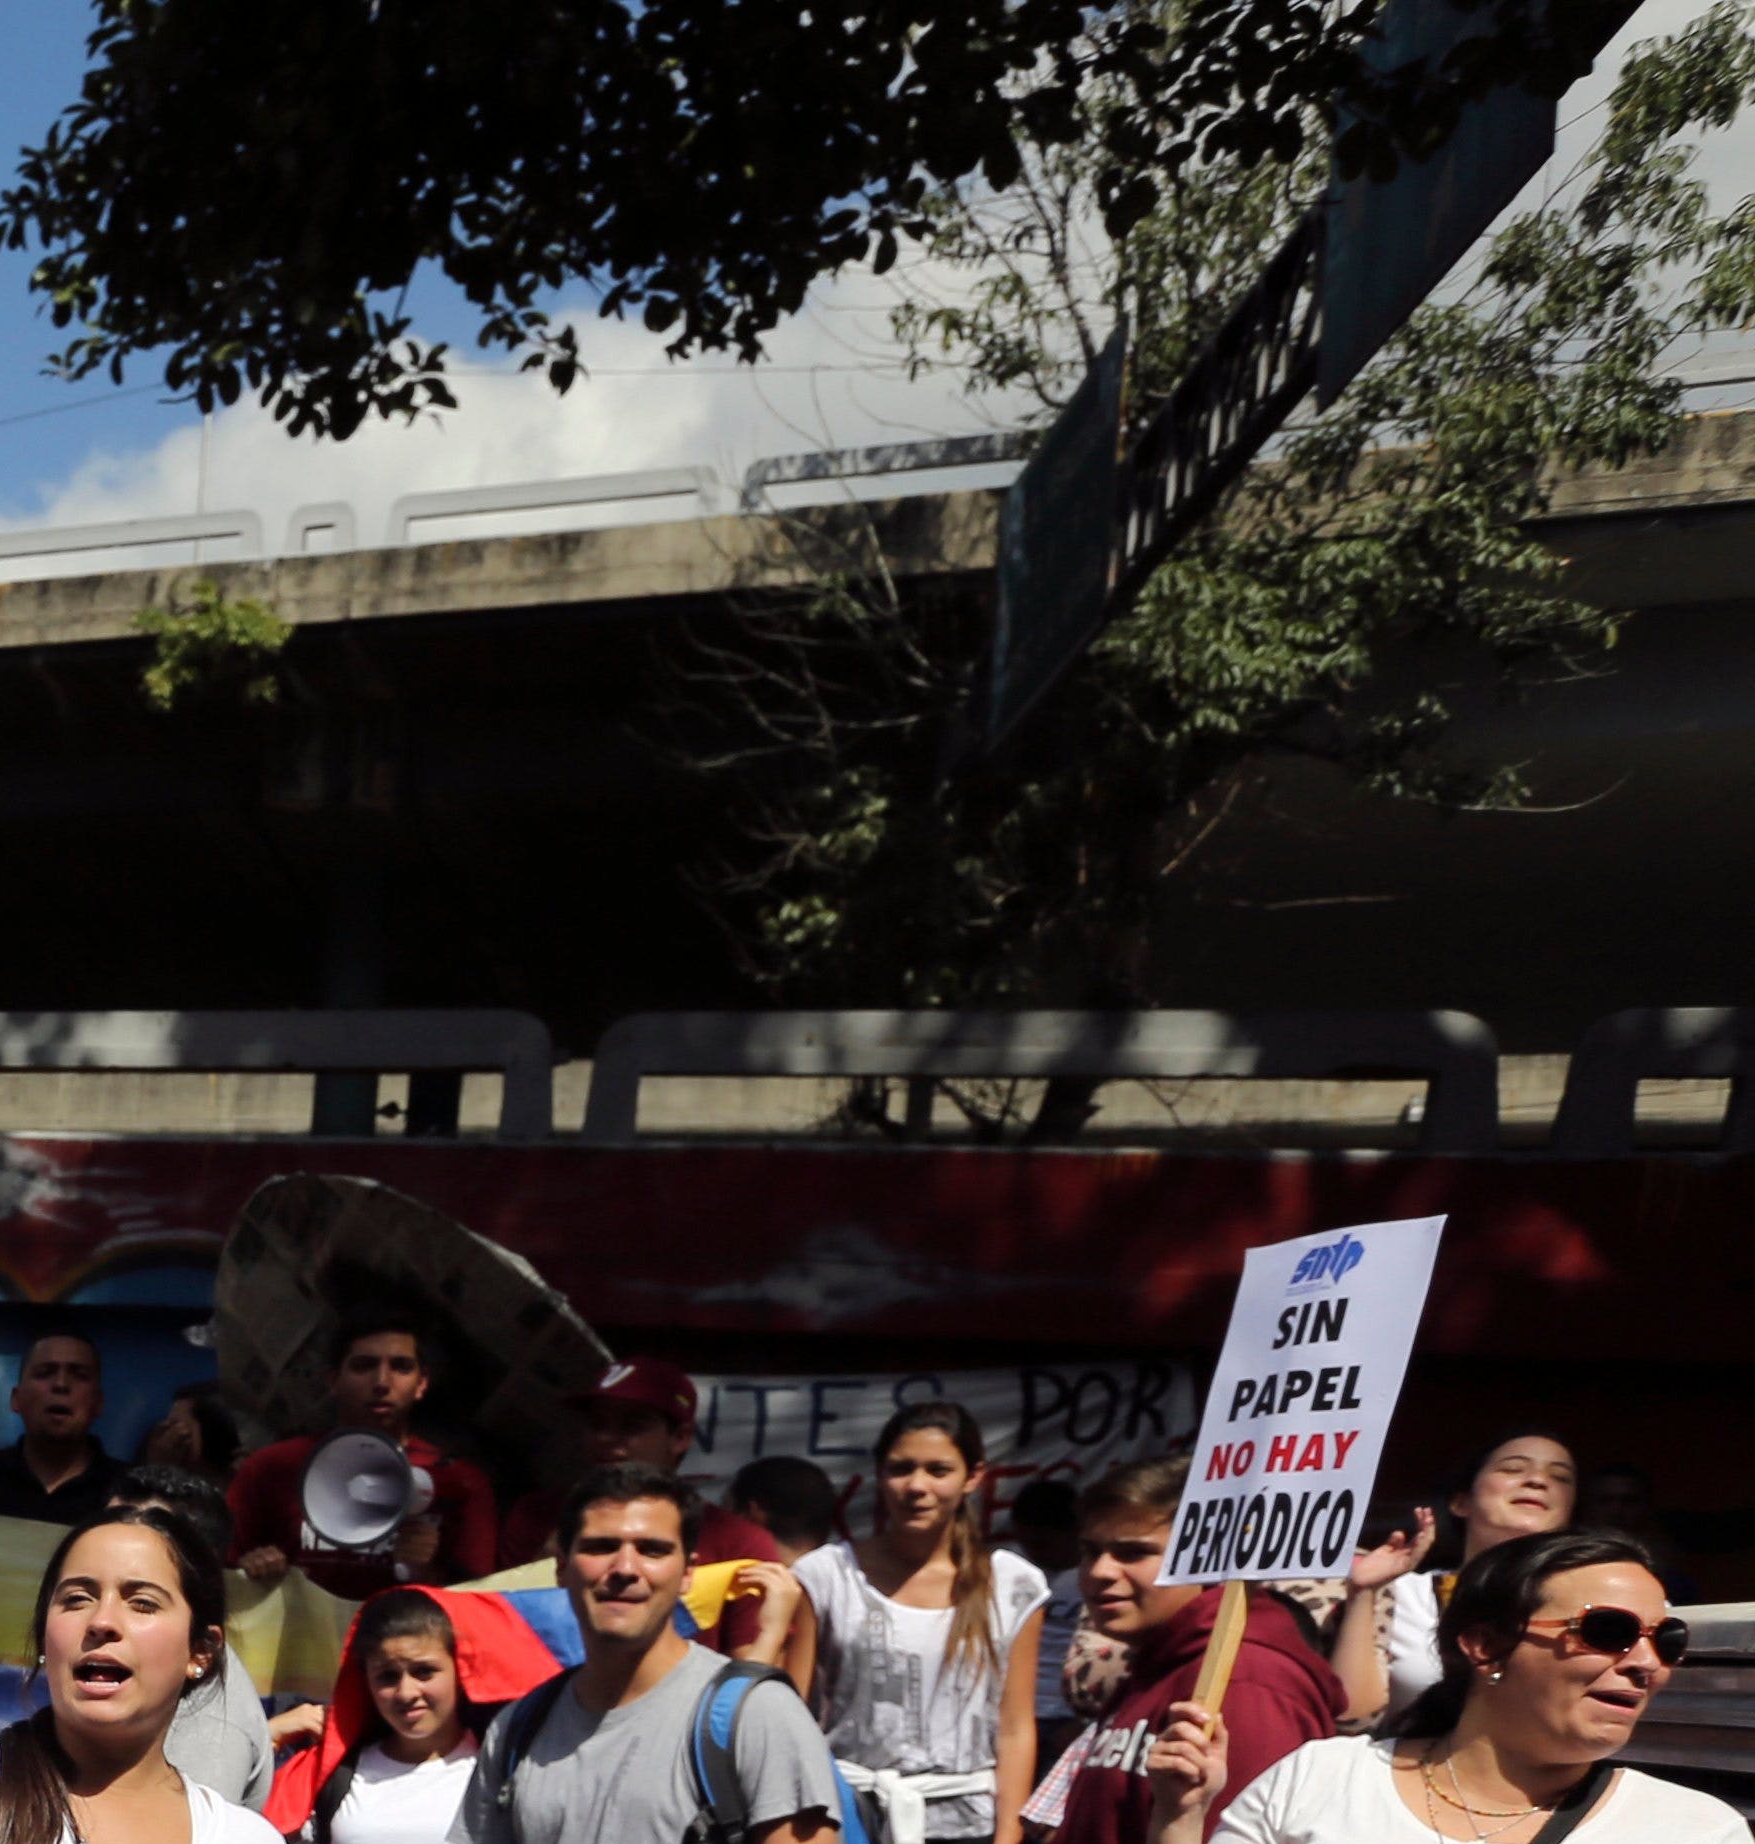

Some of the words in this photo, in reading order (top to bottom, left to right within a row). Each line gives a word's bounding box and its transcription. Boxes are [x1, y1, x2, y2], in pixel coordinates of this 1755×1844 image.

[1272, 1298, 1349, 1350] SIN
[1016, 1363, 1172, 1449] POR
[1227, 1366, 1362, 1423] PAPEL
[1204, 1440, 1255, 1481] NO
[1263, 1429, 1361, 1473] HAY
[1168, 1485, 1355, 1577] PERIÓDICO
